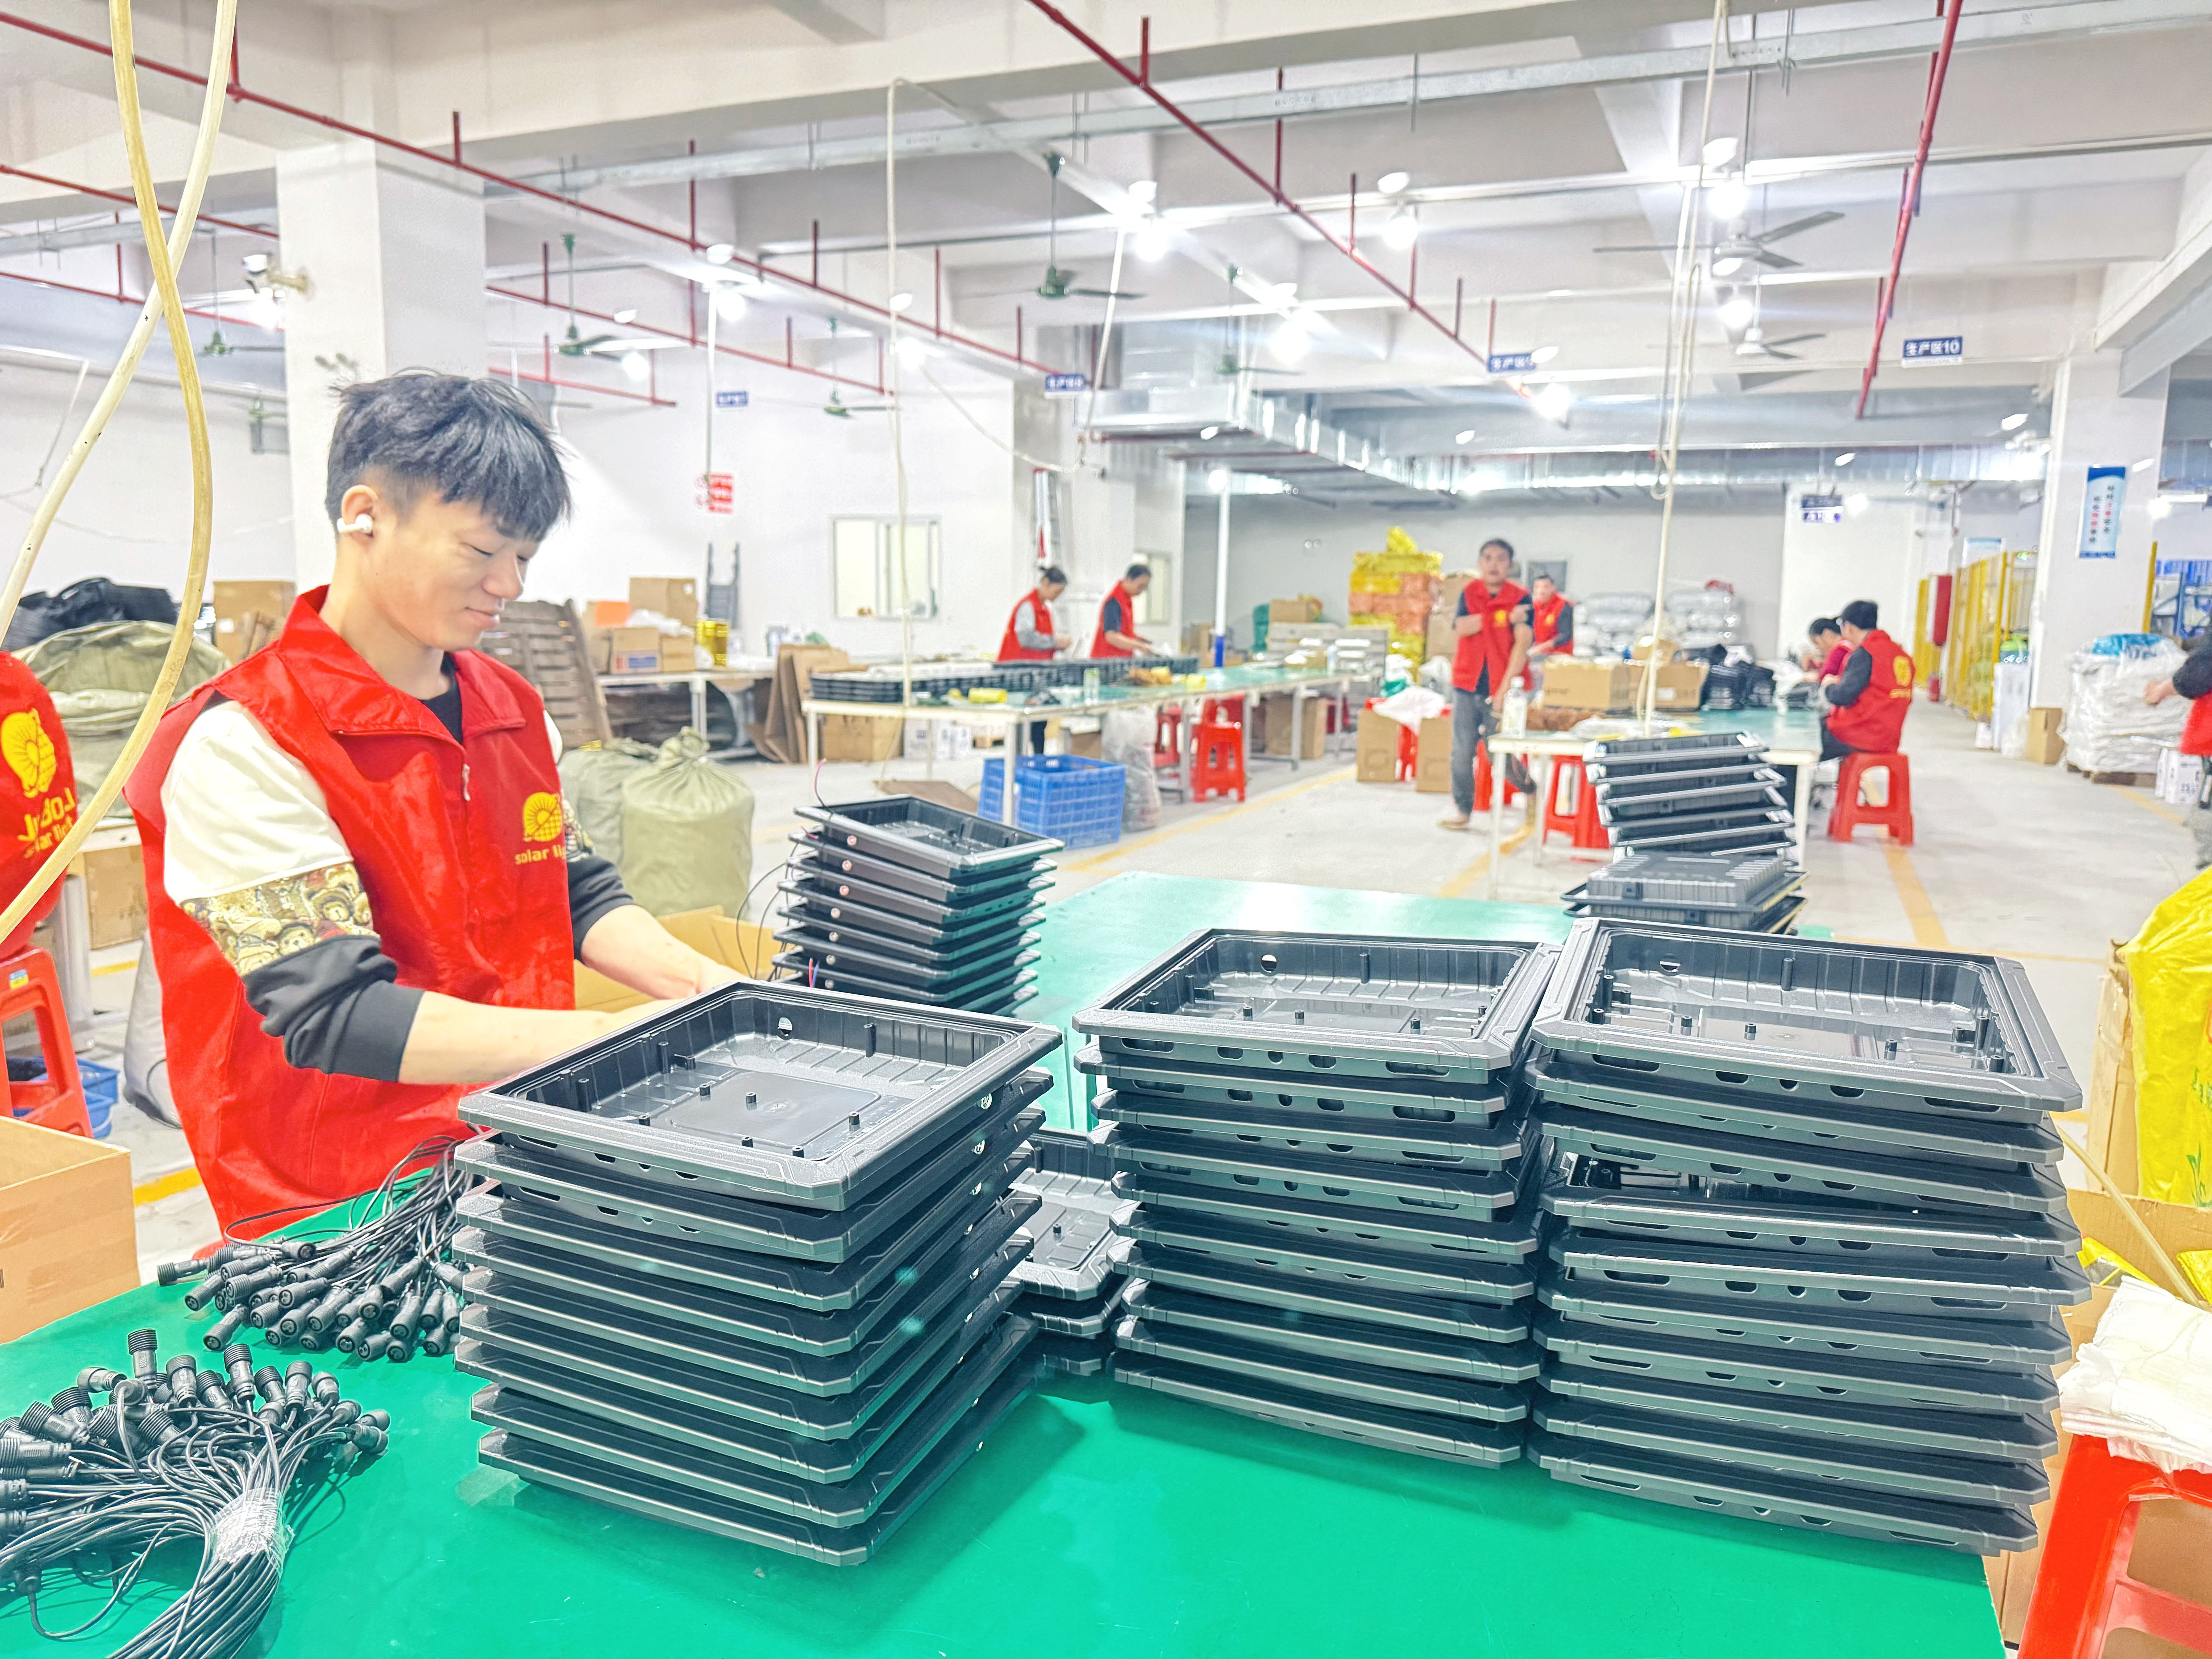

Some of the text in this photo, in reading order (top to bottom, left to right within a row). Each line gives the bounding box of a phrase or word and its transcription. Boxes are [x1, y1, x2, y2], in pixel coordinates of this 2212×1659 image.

[1905, 339, 1960, 356] 生产区10
[514, 848, 550, 866] solar
